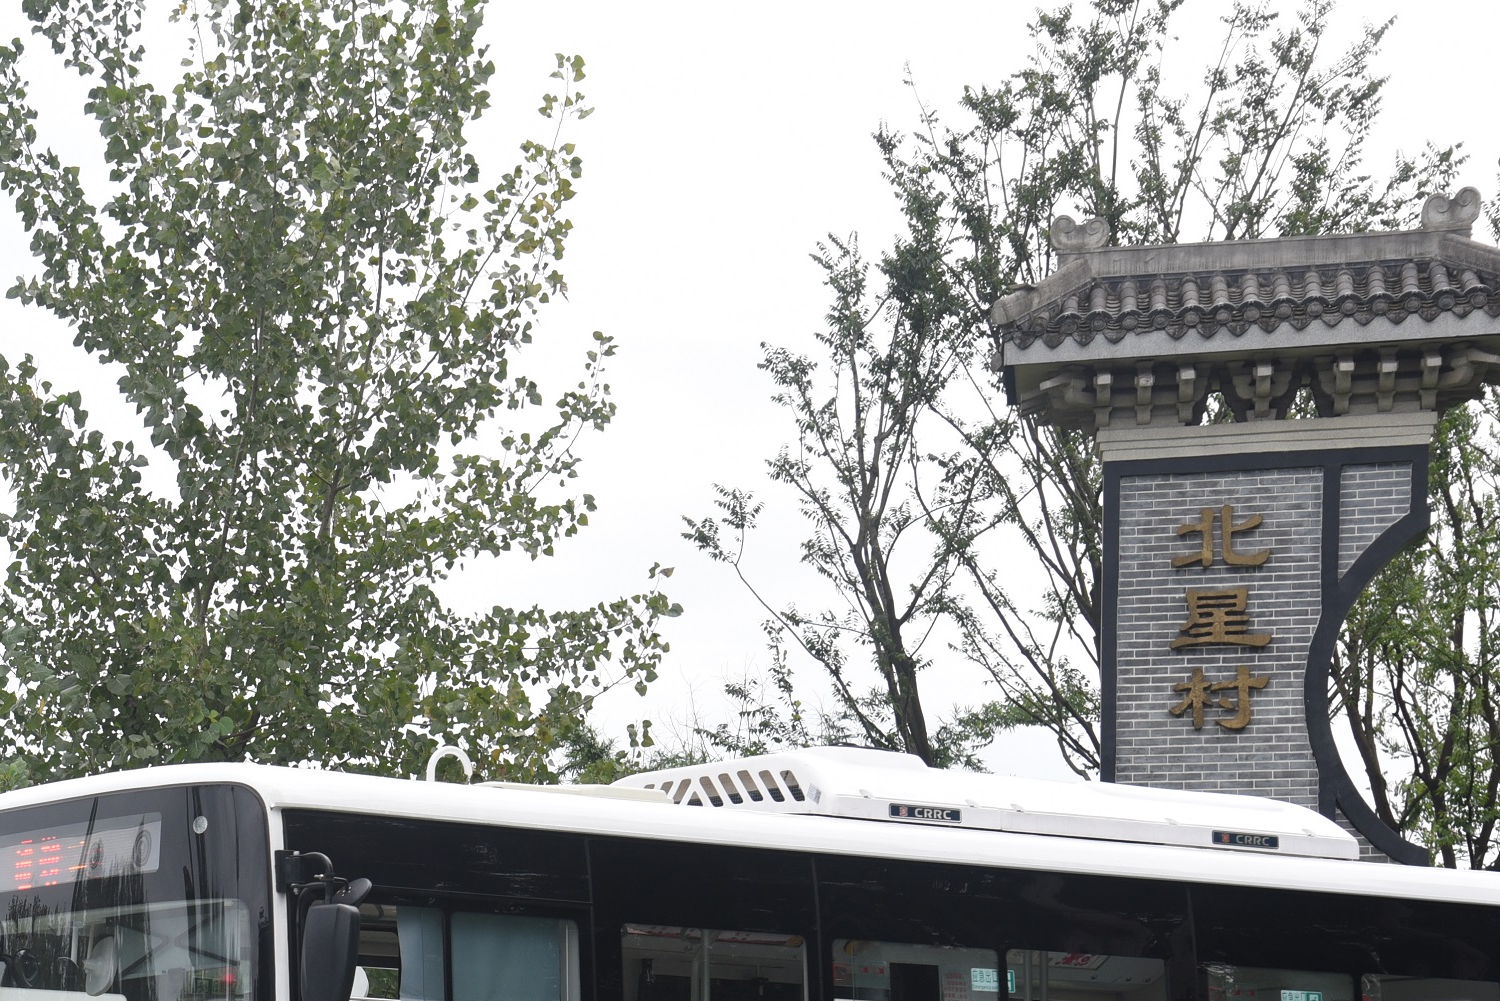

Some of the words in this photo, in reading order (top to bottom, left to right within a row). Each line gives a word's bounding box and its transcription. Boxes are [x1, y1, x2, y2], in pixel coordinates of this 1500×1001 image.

[1168, 503, 1272, 731] 北星村
[914, 807, 952, 821] CRRC
[1235, 834, 1271, 848] CRRC
